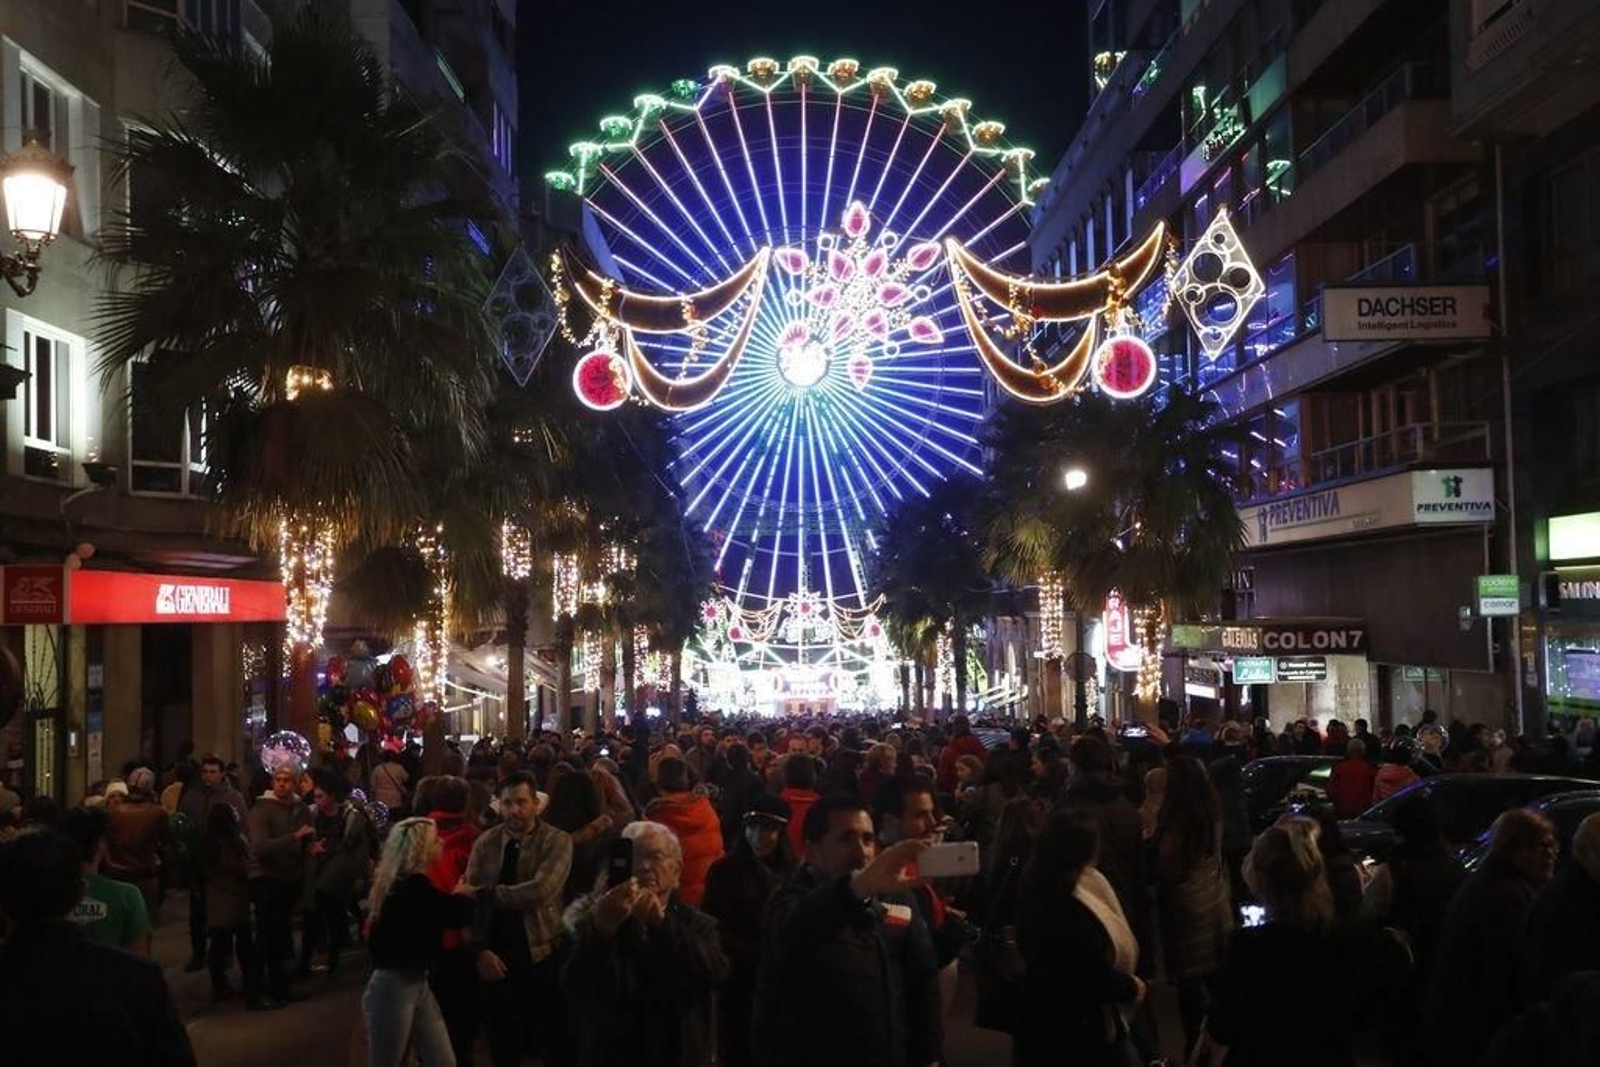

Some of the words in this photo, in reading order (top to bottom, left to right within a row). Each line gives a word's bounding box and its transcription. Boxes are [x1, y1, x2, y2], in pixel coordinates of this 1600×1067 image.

[1357, 297, 1457, 318] DACHSER
[1357, 320, 1409, 332] Intelligent
[1410, 319, 1457, 330] Logistics
[1268, 492, 1340, 525] PREVENTIVA
[1416, 501, 1492, 513] PREVENTIVA
[175, 585, 230, 614] GENERALI
